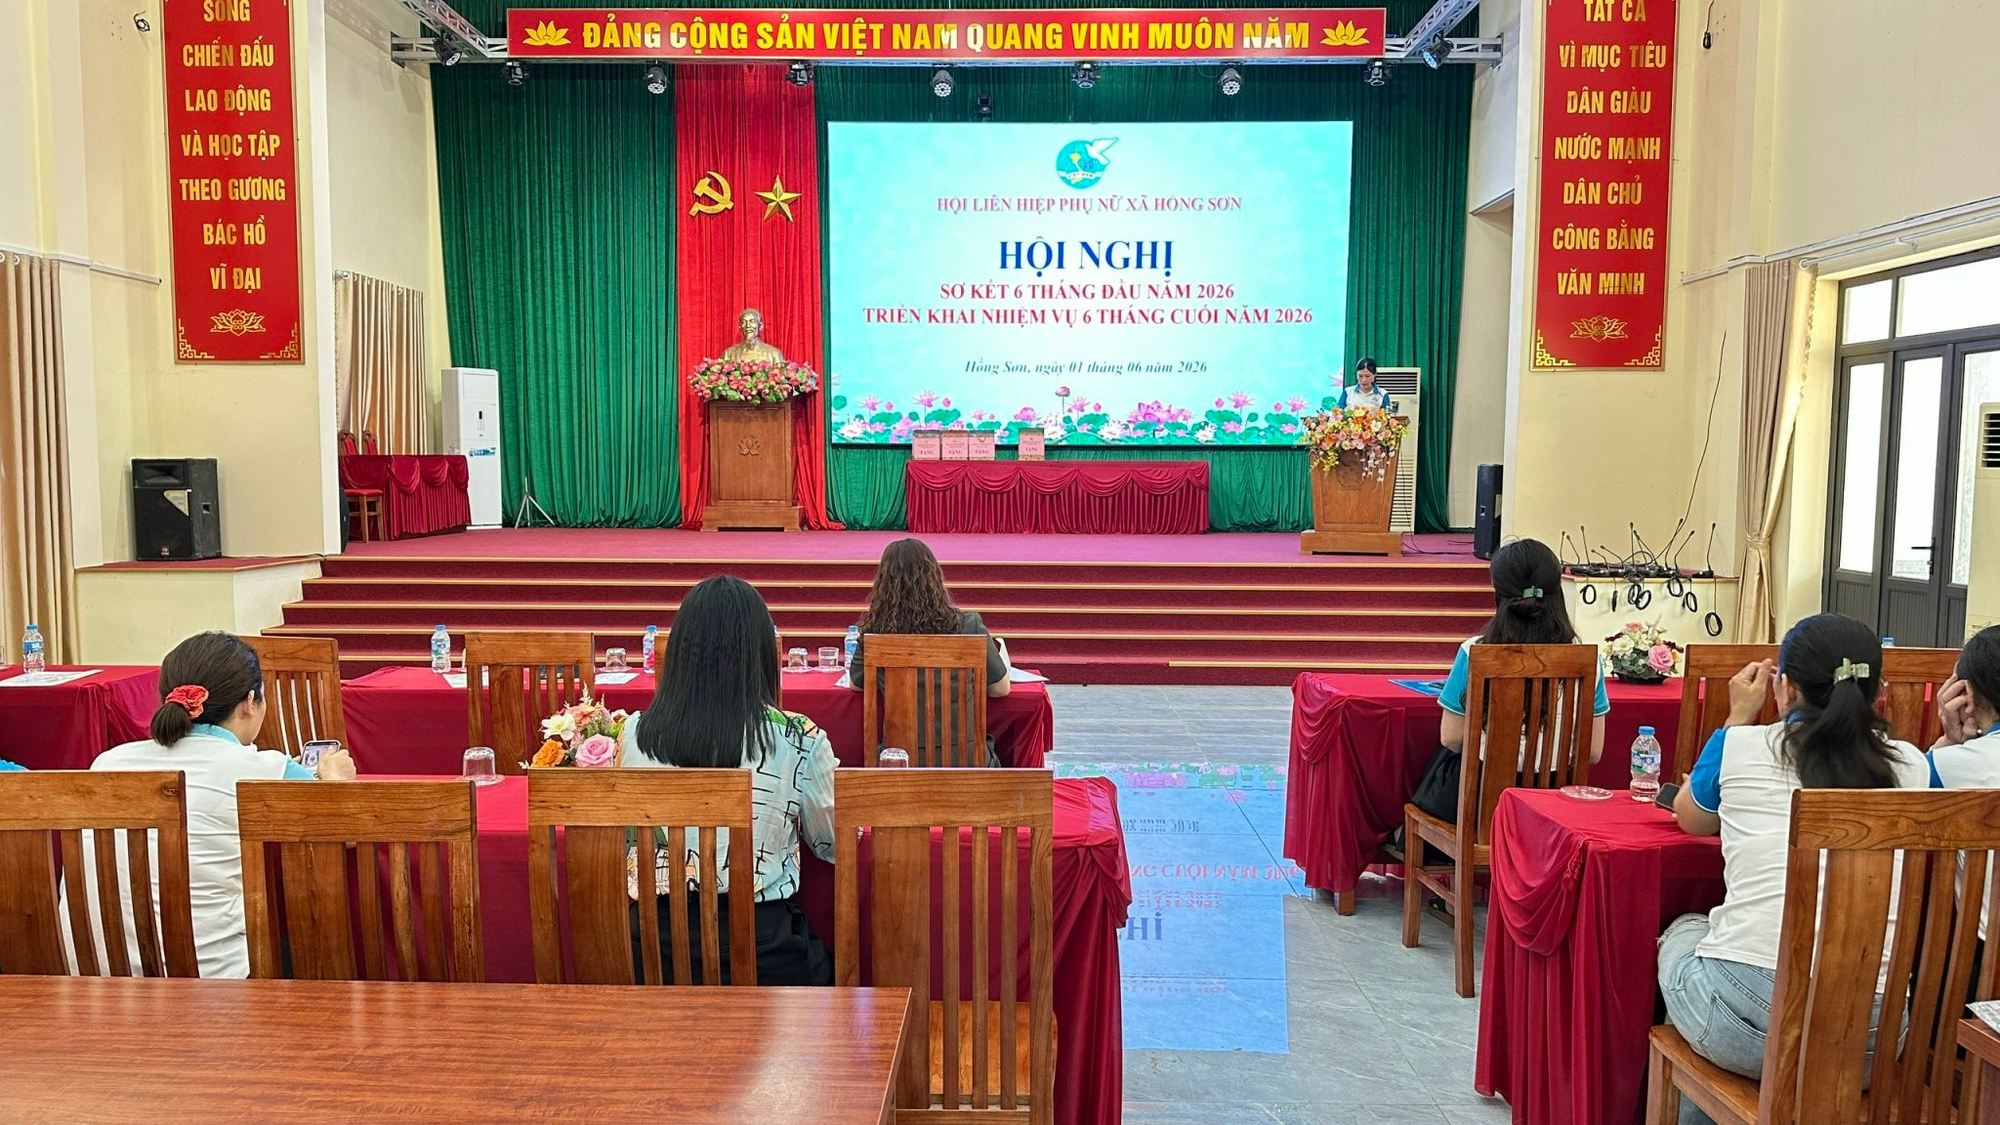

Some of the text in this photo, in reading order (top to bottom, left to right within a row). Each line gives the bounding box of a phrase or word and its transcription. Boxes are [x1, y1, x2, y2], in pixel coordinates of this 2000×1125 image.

[583, 13, 1309, 55] ĐẢNG CỘNG SẢN VIỆT NAM QUANG VINH MUÔN NĂM
[182, 35, 274, 67] CHIẾN ĐẤU
[1559, 40, 1667, 72] VÌ MỤC TIÊU
[185, 84, 271, 116] LAO ĐỘNG
[1567, 86, 1651, 114] DÂN GIÀU
[181, 130, 281, 161] VÀ HỌC TẬP
[1555, 132, 1661, 164] NƯỚC MẠNH
[180, 176, 286, 201] THEO GƯƠNG
[1563, 175, 1642, 205] DÂN CHỦ
[937, 196, 968, 215] HỘI
[973, 194, 1012, 212] LIÊN
[1017, 196, 1056, 215] HIỆP
[1059, 198, 1093, 215] PHỤ
[1098, 194, 1124, 212] NỮ
[1126, 194, 1150, 212] XÃ
[1208, 196, 1242, 212] SƠN
[203, 214, 266, 246] BÁC HỒ
[1553, 219, 1654, 250] CÔNG BẰNG
[999, 236, 1174, 278] HỘI NGHỊ
[210, 263, 261, 293] VĨ ĐẠI
[940, 283, 966, 299] SƠ
[1014, 284, 1023, 299] 6
[1028, 279, 1096, 299] THÁNG
[1147, 279, 1191, 299] NĂM
[1197, 284, 1235, 299] 2026
[1557, 268, 1645, 295] VĂN MINH
[928, 308, 976, 324] KHAI
[981, 306, 1046, 328] NHIỆM
[1052, 309, 1077, 328] VỤ
[1082, 309, 1092, 324] 6
[1097, 304, 1165, 324] THÁNG
[1225, 304, 1269, 324] NĂM
[1275, 308, 1313, 324] 2026
[965, 357, 999, 375] Hồng
[1035, 360, 1065, 376] ngày
[1069, 361, 1083, 373] 01
[1087, 361, 1123, 375] tháng
[1127, 361, 1142, 373] 06
[1146, 361, 1173, 373] năm
[1177, 361, 1207, 373] 2026
